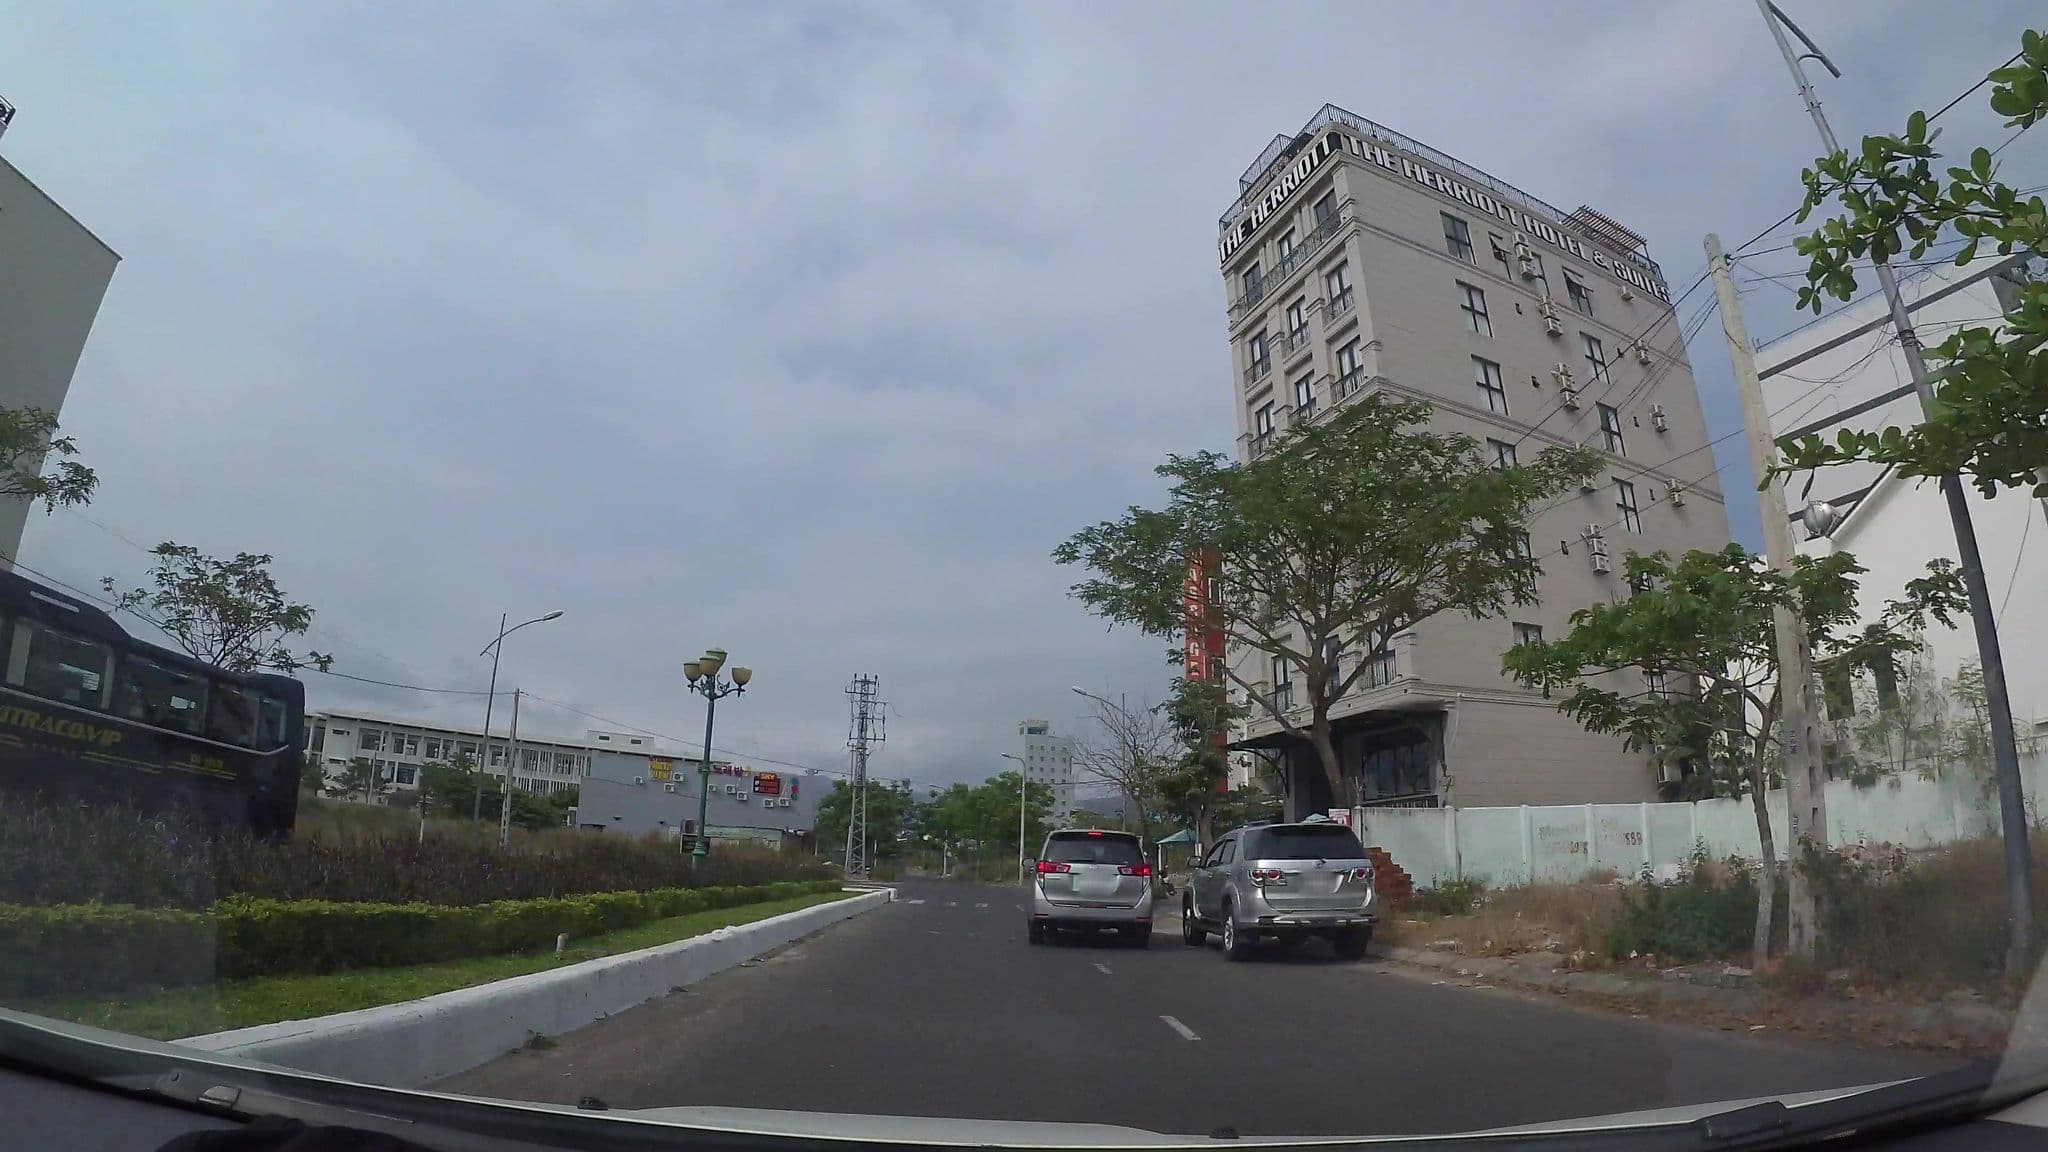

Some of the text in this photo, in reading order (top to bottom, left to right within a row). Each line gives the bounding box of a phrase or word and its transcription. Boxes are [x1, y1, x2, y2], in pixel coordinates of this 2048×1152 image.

[1220, 134, 1331, 261] THE HERRIOTT
[1345, 135, 1672, 305] THE HERRIOTT HOTEL & SUITES
